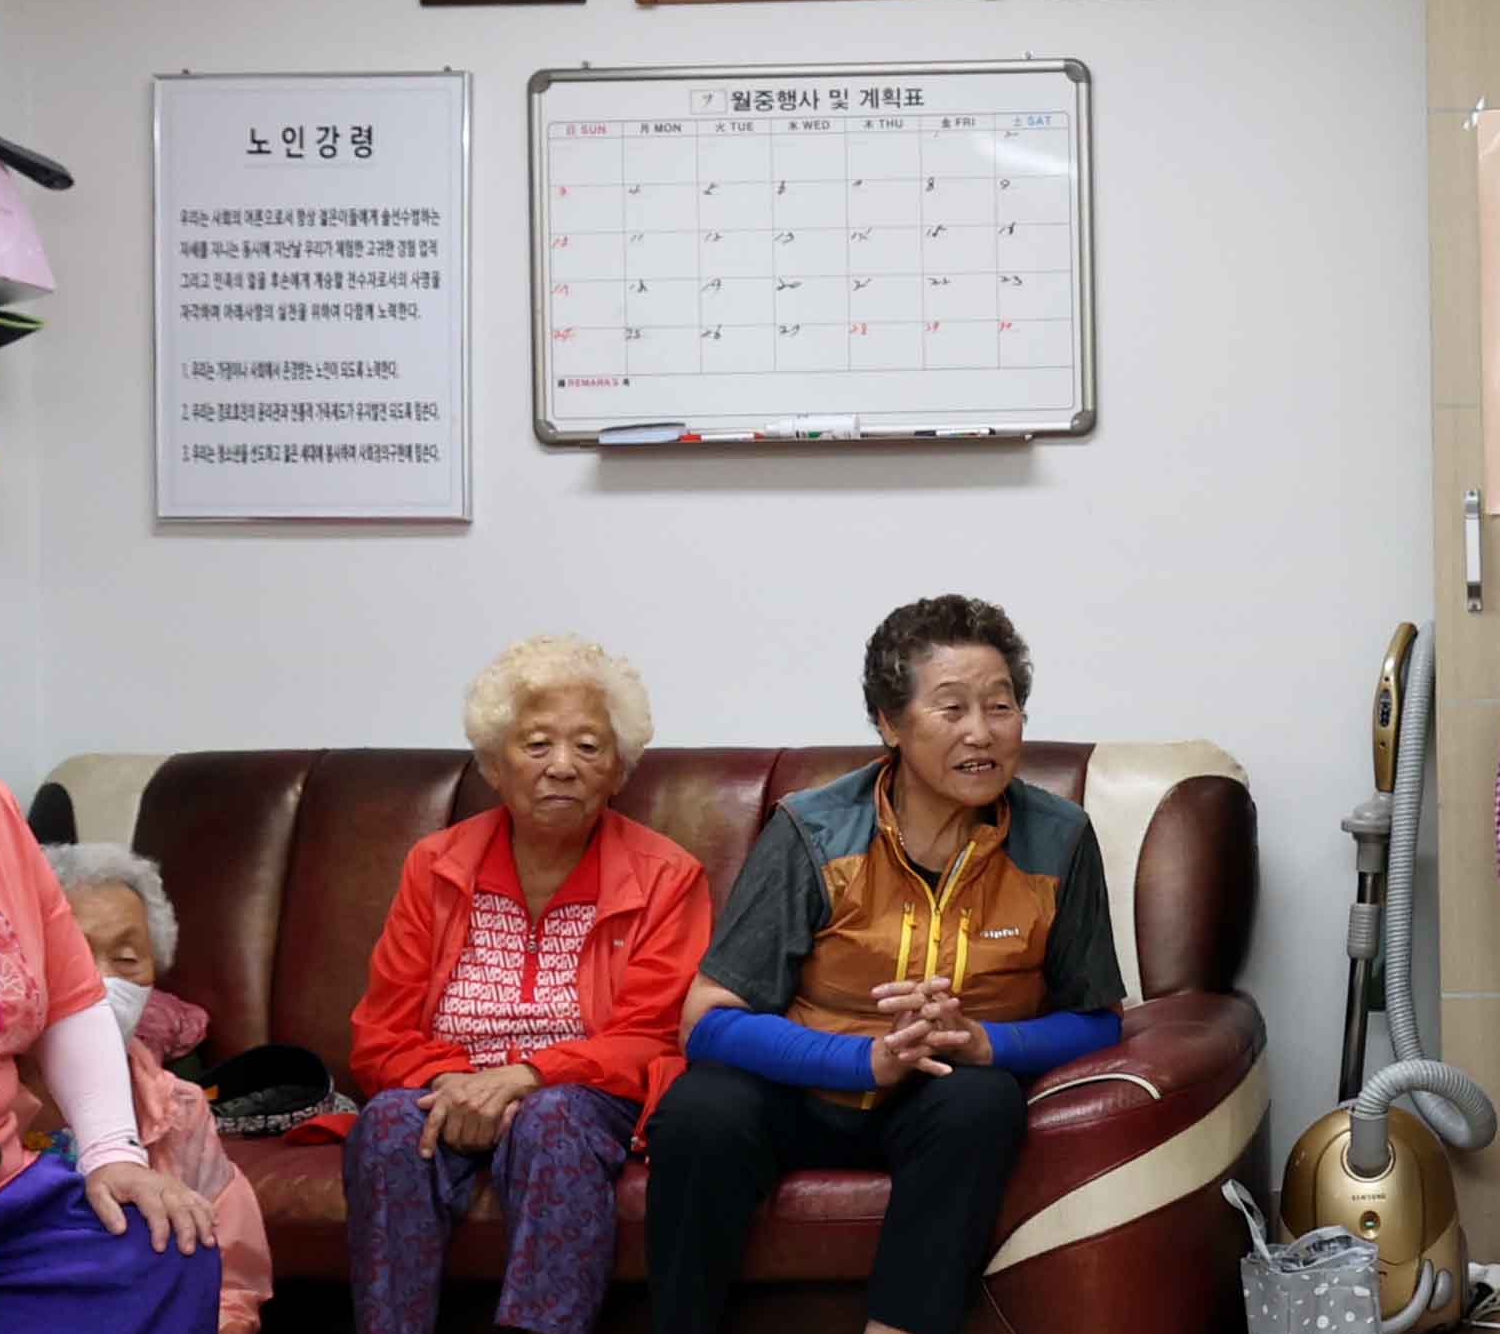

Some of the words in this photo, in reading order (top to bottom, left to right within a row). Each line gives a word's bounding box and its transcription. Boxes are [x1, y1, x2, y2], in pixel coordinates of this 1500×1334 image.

[731, 88, 819, 112] 월중행사
[829, 89, 848, 110] 및
[860, 87, 925, 110] 계획표
[731, 121, 754, 132] TUE
[802, 120, 830, 130] WED
[879, 118, 903, 129] THU
[955, 118, 975, 127] FRI
[1027, 116, 1053, 126] SAT
[581, 123, 606, 135] SUN
[654, 122, 682, 133] MON
[246, 125, 373, 159] 노인강령
